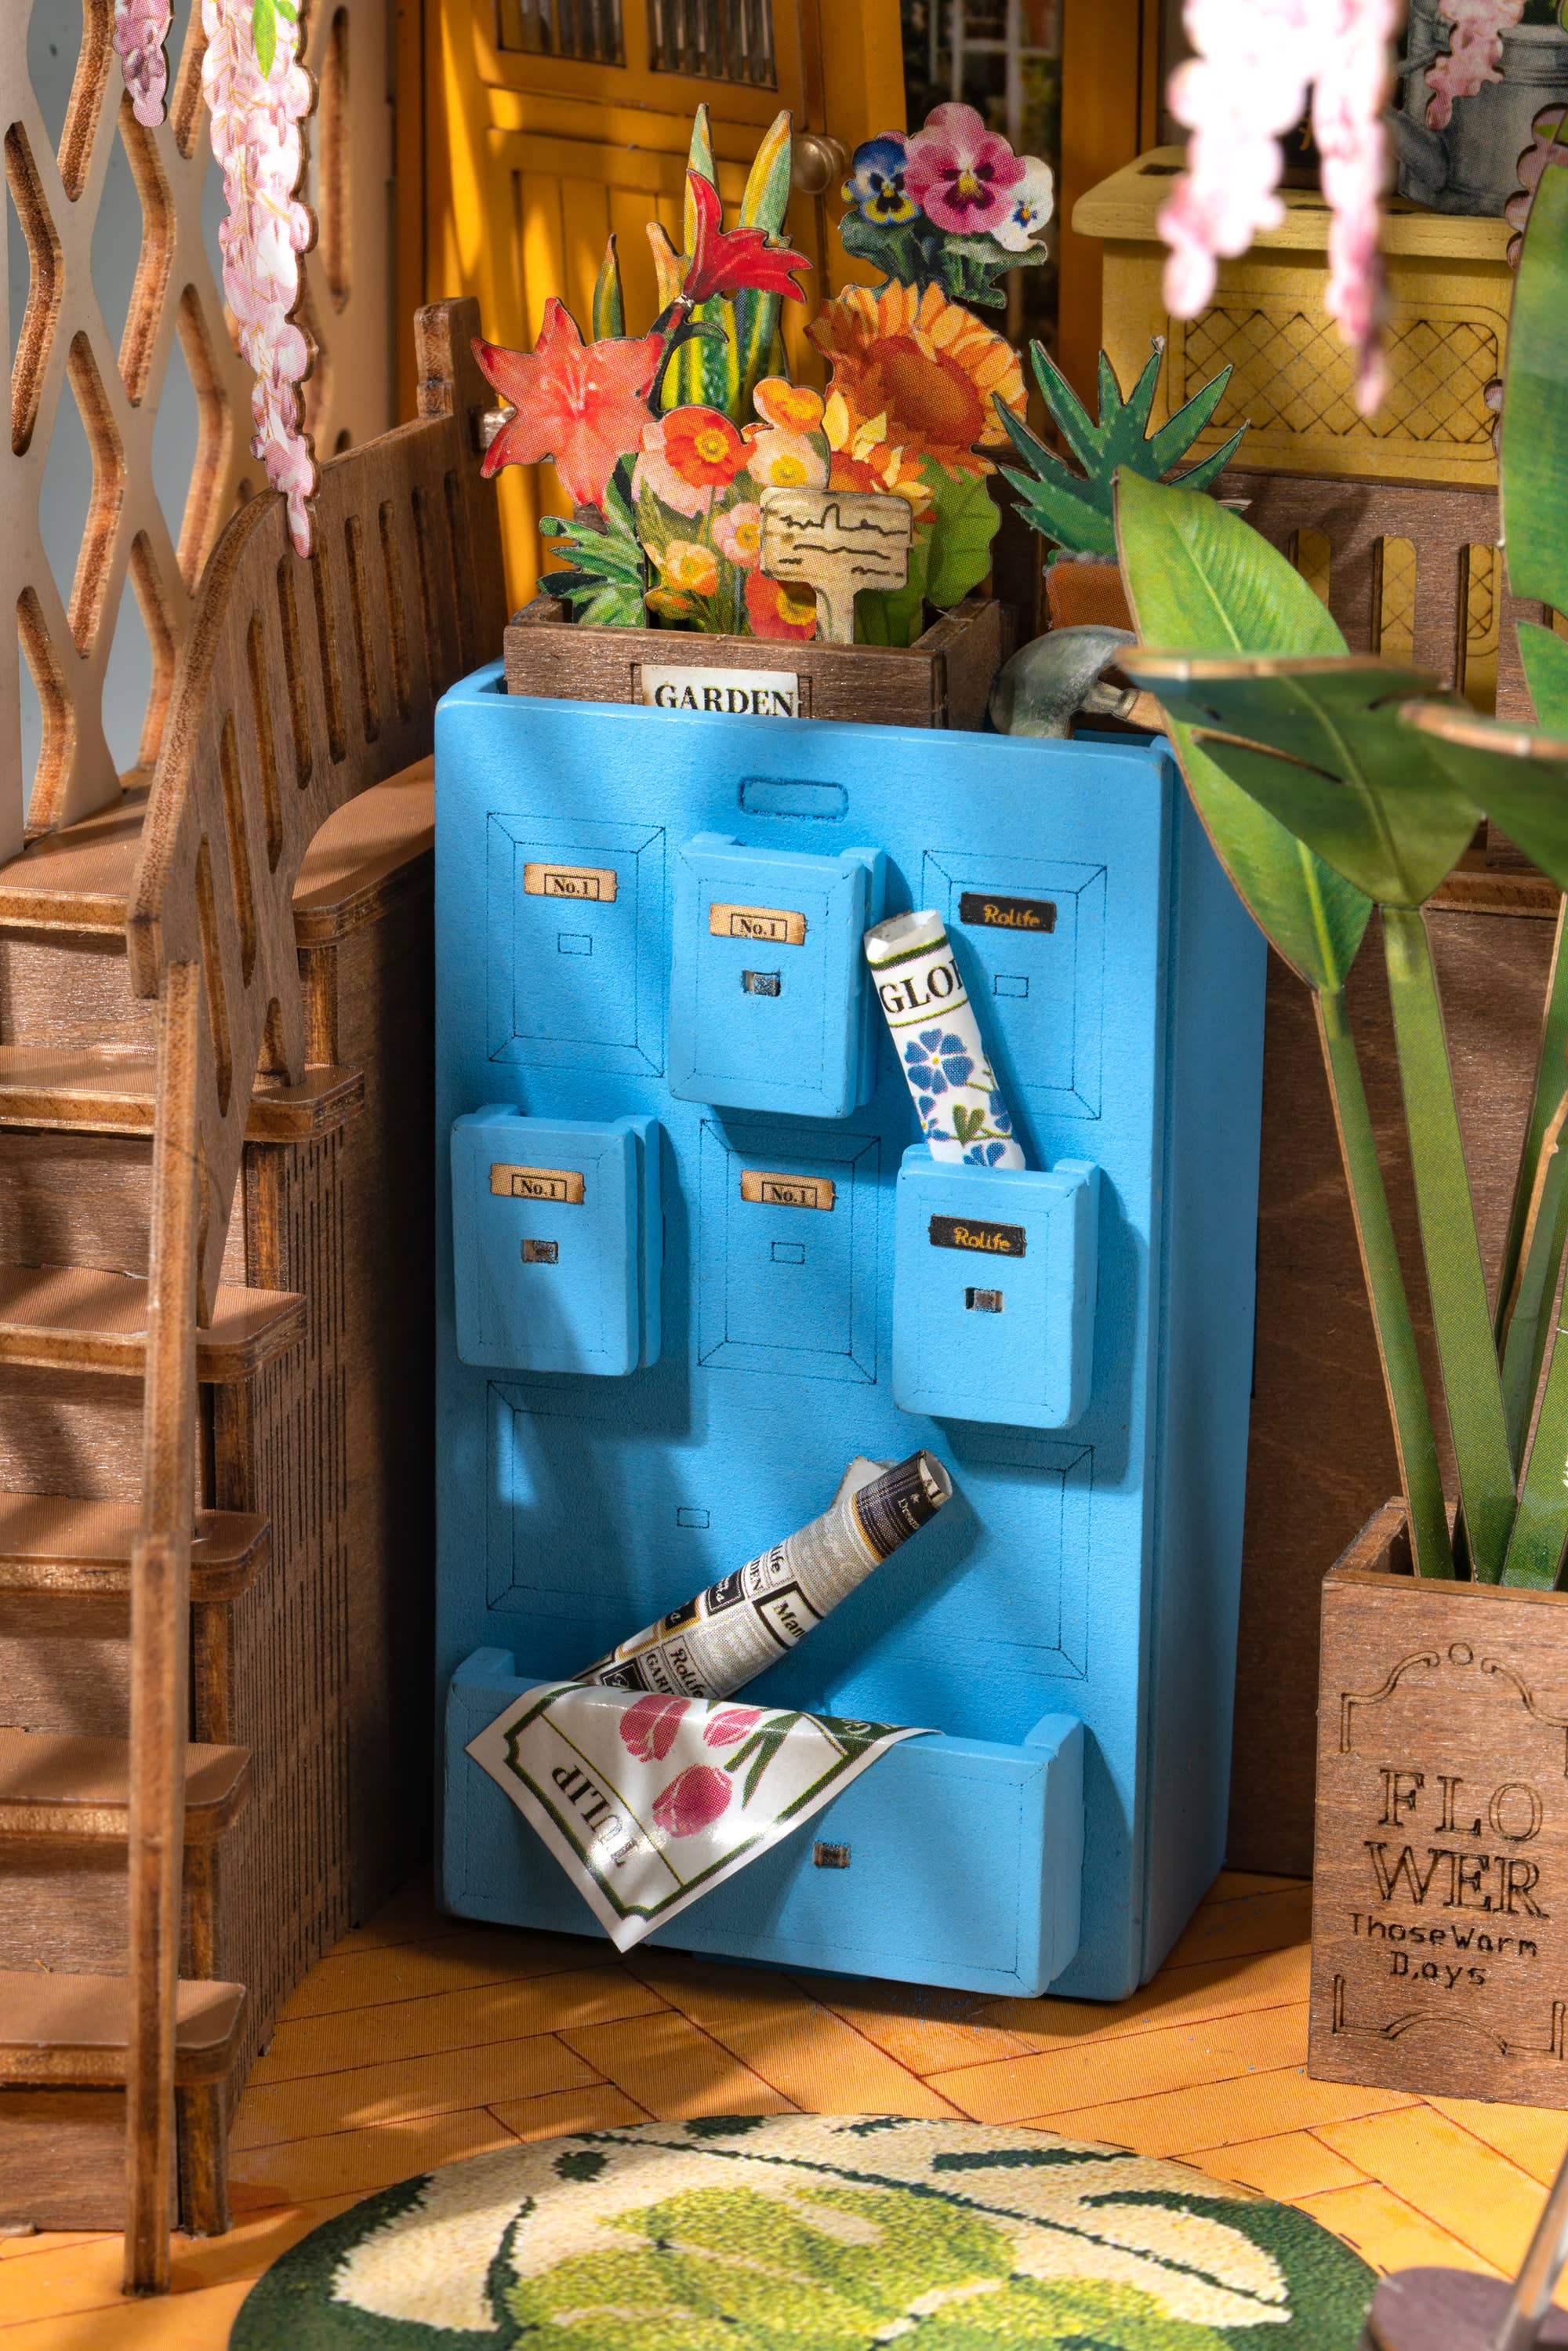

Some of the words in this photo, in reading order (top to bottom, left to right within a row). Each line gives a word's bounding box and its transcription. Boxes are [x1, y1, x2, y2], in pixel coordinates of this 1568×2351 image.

[655, 683, 796, 717] GARDEN
[554, 878, 588, 894] No.1
[740, 918, 775, 936] No.1
[521, 1179, 555, 1196] No.1
[771, 1186, 805, 1203] No.1
[953, 1226, 1011, 1252] Rolife
[552, 1764, 638, 1868] TULIP
[1377, 1769, 1544, 1842] FLO
[1364, 1840, 1550, 1920] WER
